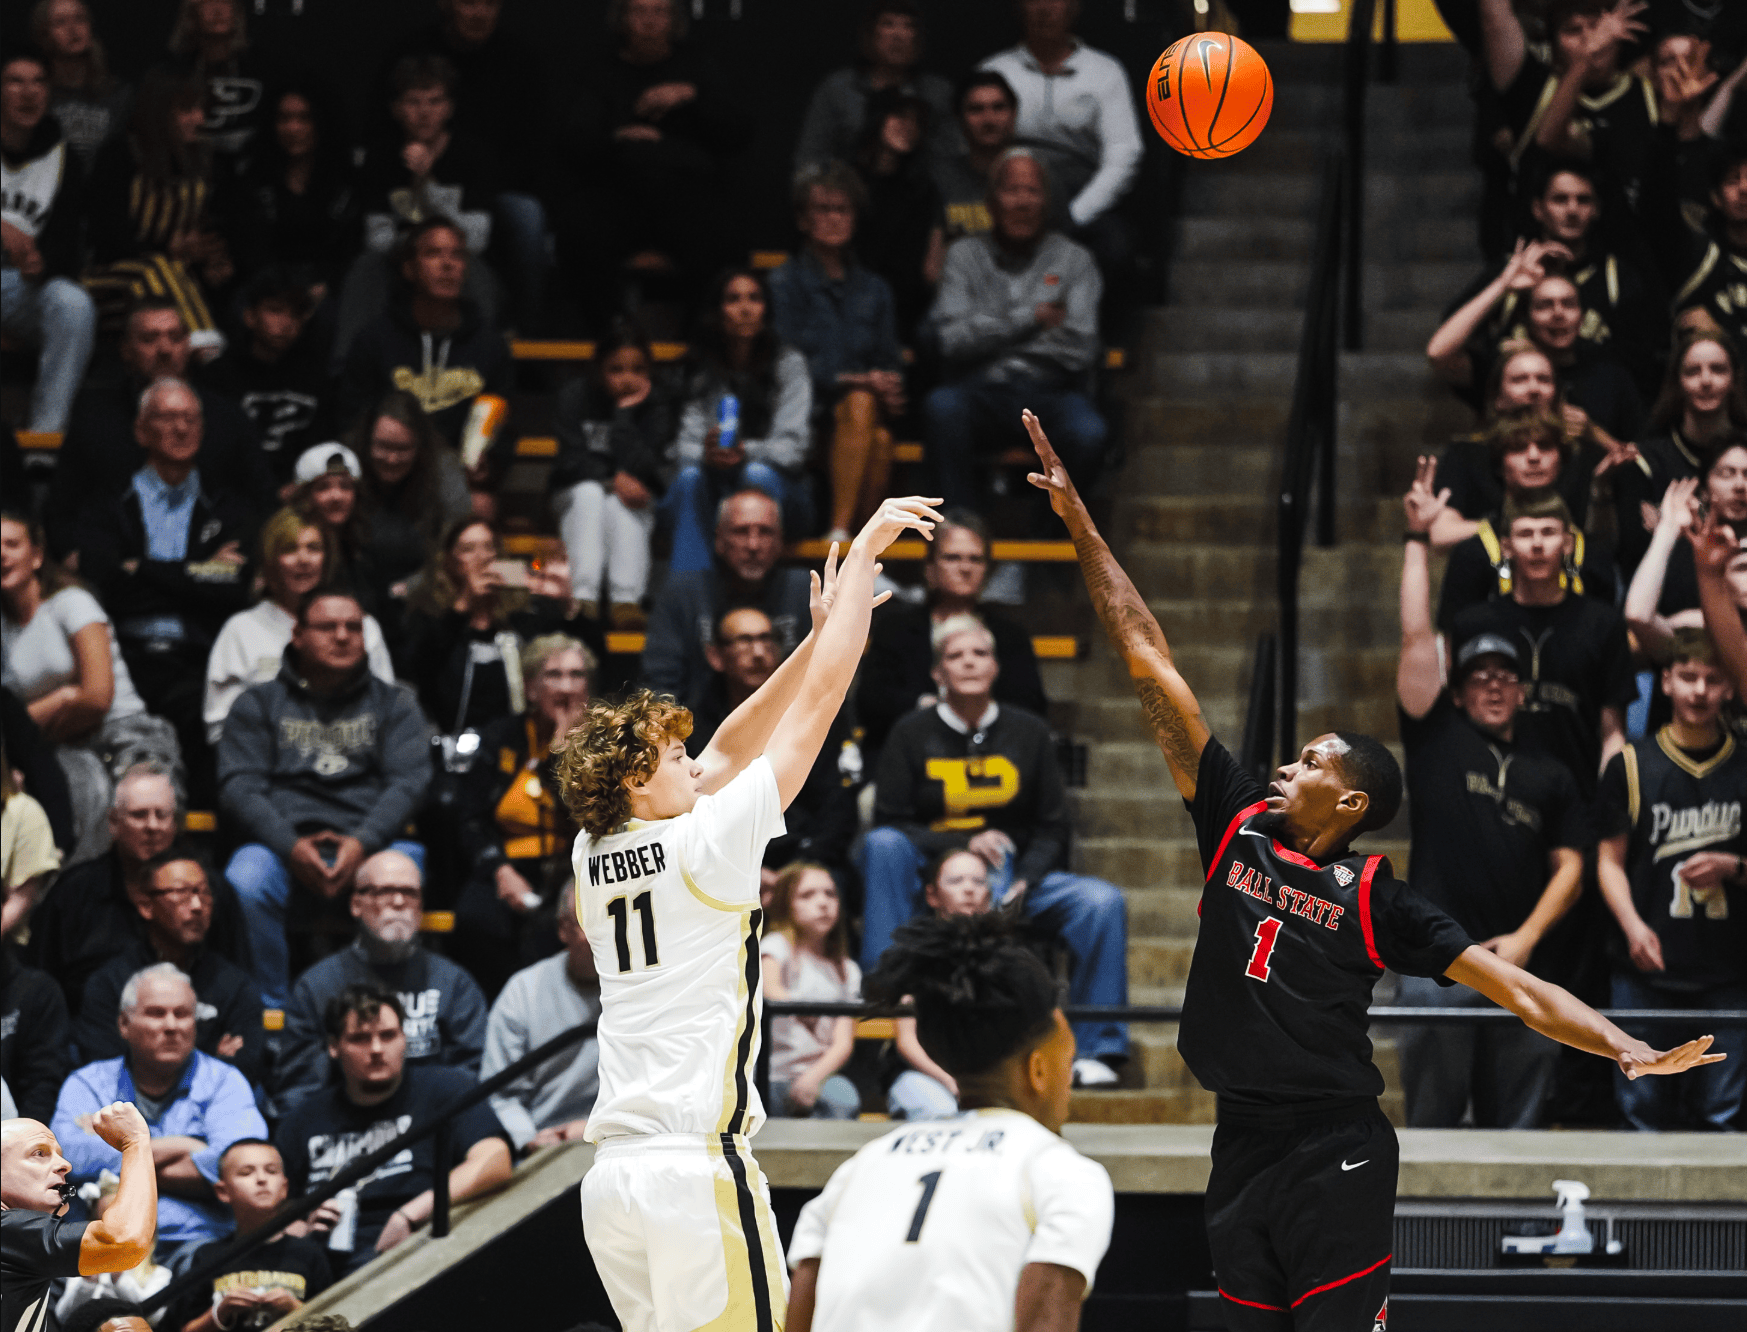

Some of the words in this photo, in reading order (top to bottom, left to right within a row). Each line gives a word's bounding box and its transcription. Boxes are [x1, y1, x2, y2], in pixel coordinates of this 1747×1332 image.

[1157, 41, 1181, 101] ELITE
[925, 753, 1021, 832] P
[588, 842, 666, 886] WEBBER
[1226, 860, 1273, 905] BALL
[1276, 885, 1345, 931] STATE
[606, 890, 660, 975] 11
[1245, 916, 1284, 983] 1
[889, 1128, 964, 1155] WEST
[904, 1169, 945, 1245] 1
